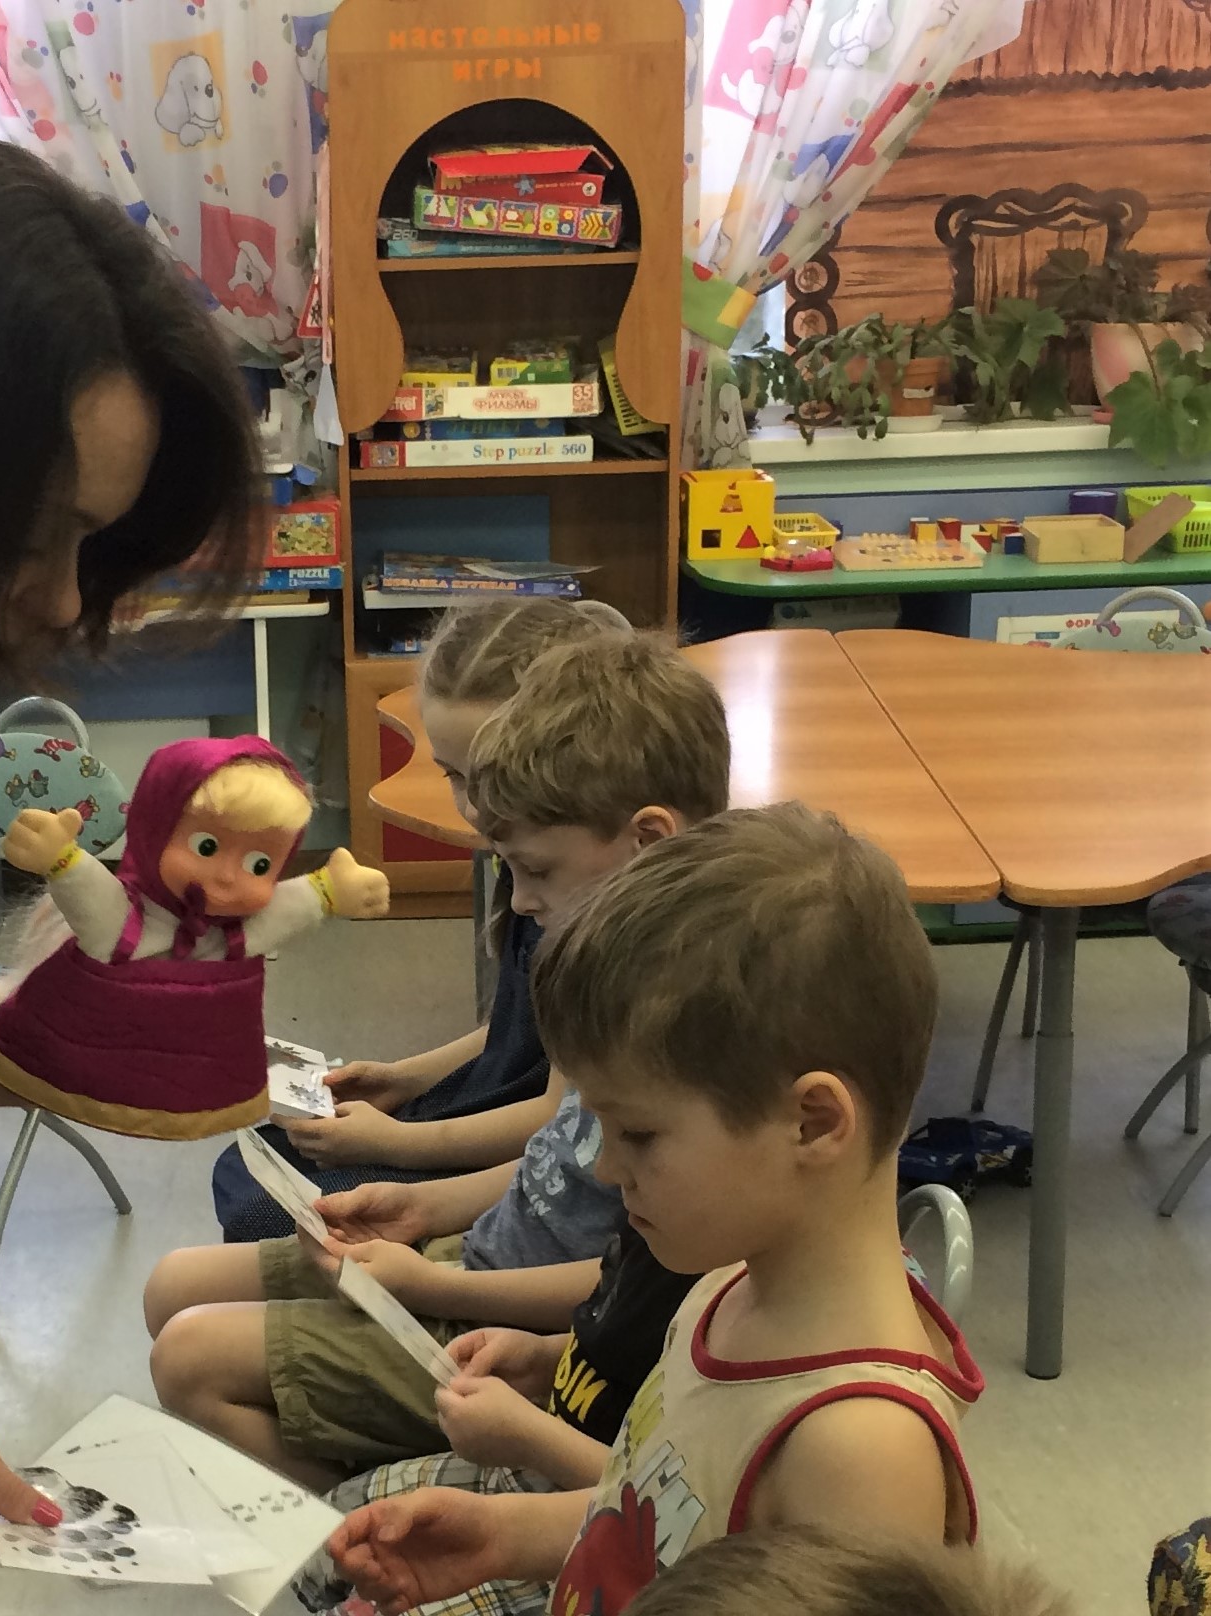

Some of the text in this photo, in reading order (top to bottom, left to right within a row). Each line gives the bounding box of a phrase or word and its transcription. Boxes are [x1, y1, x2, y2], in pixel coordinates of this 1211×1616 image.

[573, 385, 592, 401] 35
[474, 399, 538, 410] ФИЛЬМЫ
[473, 442, 587, 461] Step puzzle 560
